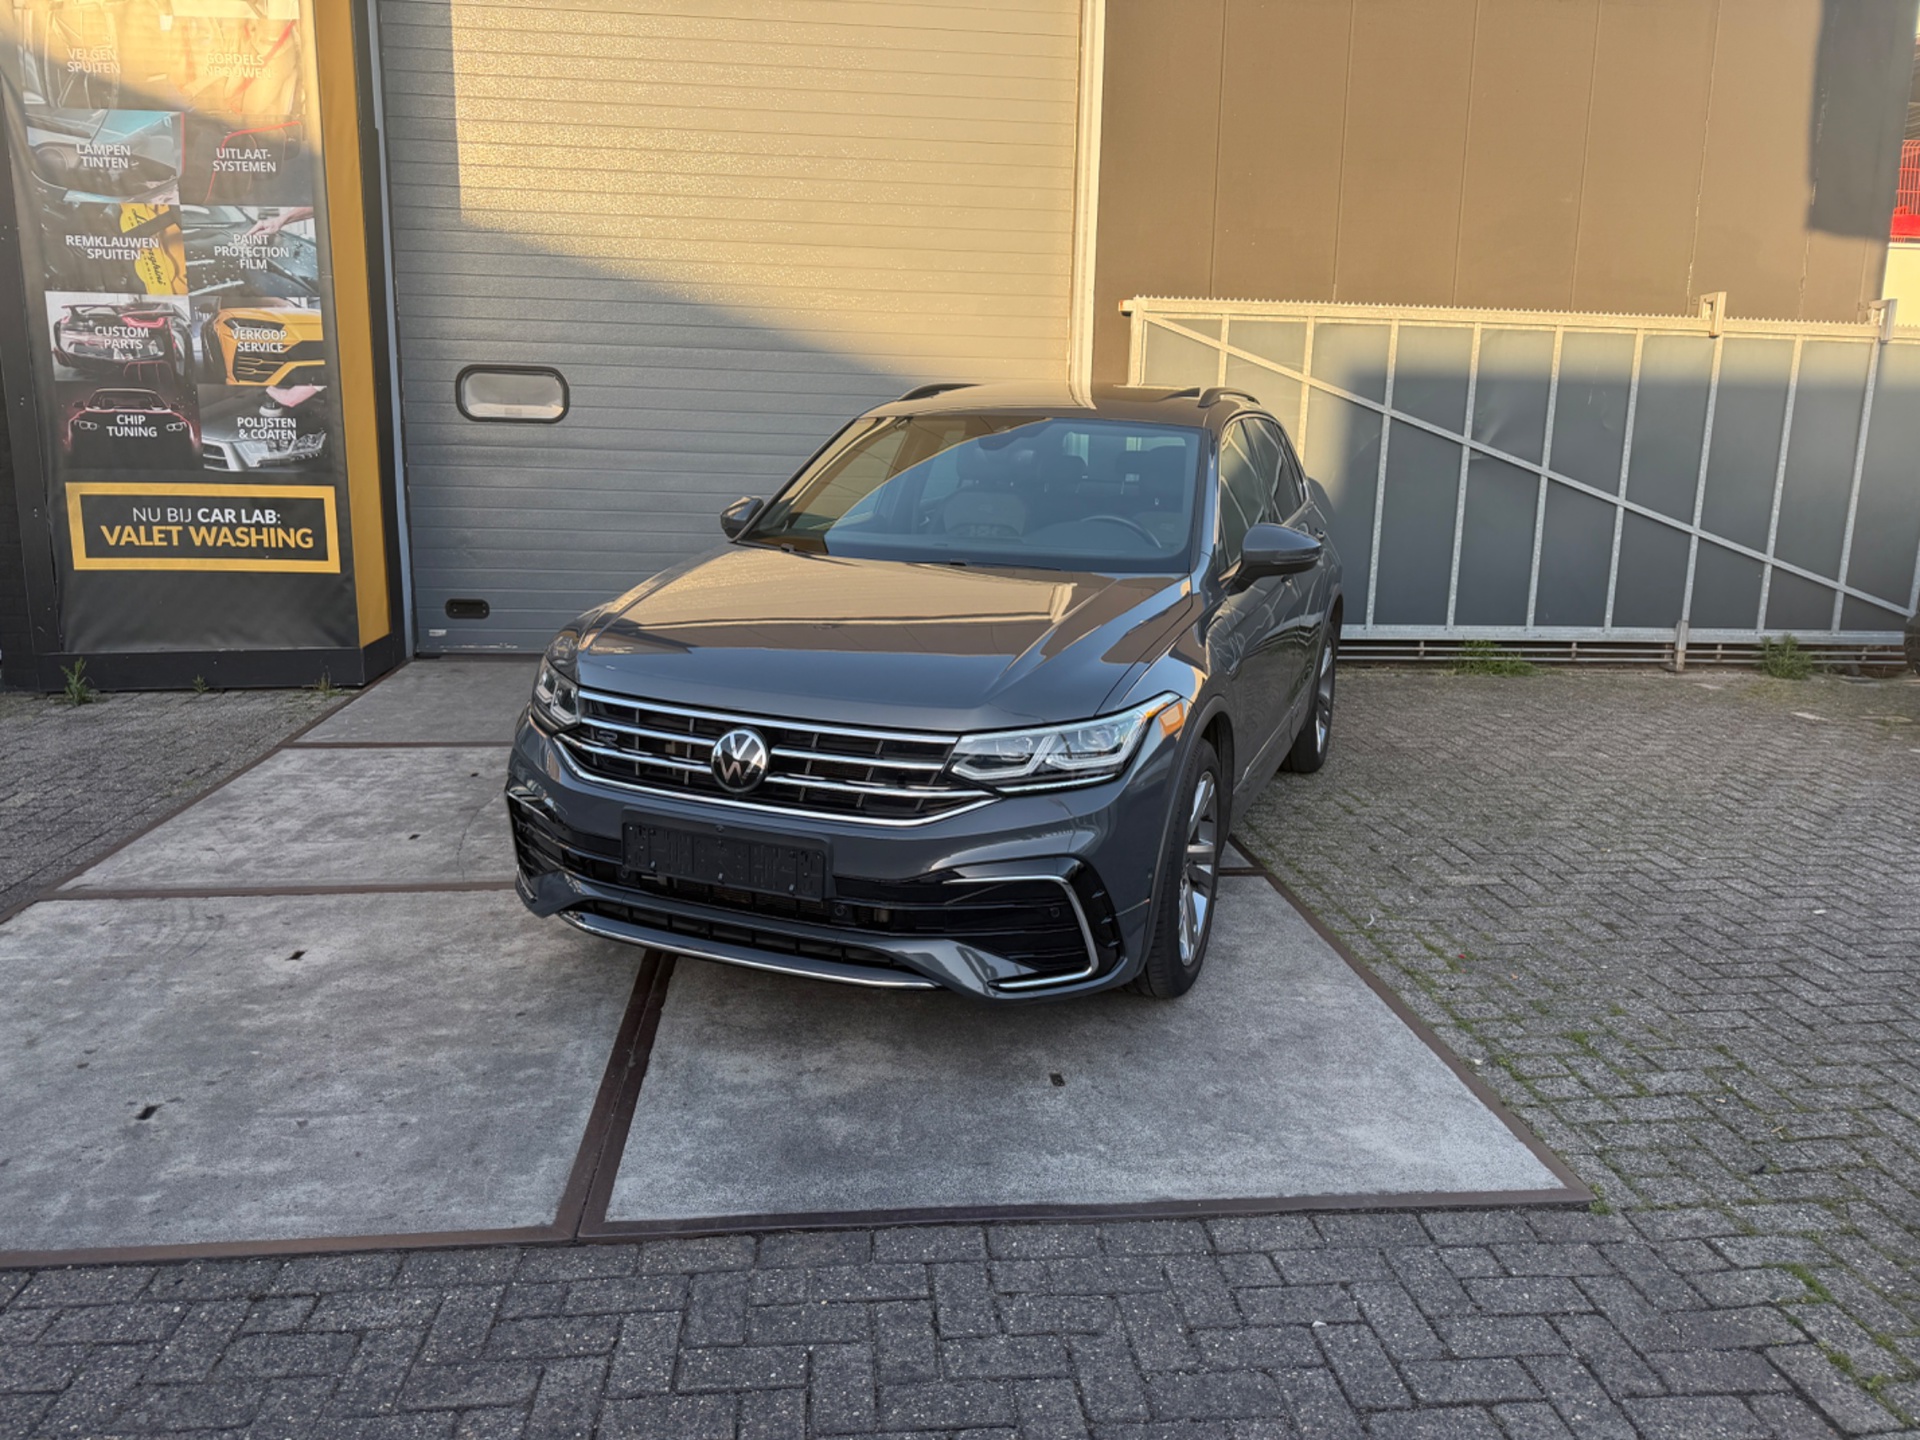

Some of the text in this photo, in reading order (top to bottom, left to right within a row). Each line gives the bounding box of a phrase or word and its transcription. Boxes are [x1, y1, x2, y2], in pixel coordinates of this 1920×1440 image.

[66, 48, 117, 60] VELGEN
[206, 53, 265, 65] GORDELS
[66, 61, 121, 74] SPUITEN
[76, 143, 131, 157] LAMPEN
[216, 148, 272, 161] UITLAAT-
[80, 156, 129, 169] TINTEN
[212, 160, 277, 173] SYSTEMEN
[65, 235, 159, 249] REMKLAUWEN
[233, 234, 269, 246] PAINT
[87, 247, 142, 261] SPUITEN
[214, 246, 290, 258] PROTECTION
[239, 258, 268, 270] FILM
[94, 326, 149, 338] CUSTOM
[231, 328, 287, 341] VERKOOP
[103, 338, 144, 350] PARTS
[237, 341, 284, 353] SERVICE
[116, 414, 147, 426] CHIP
[237, 417, 297, 430] POLIJSTEN
[106, 425, 158, 438] TUNING
[238, 428, 297, 440] & COATEN
[132, 507, 282, 525] NU BIJ CAR LAB:
[100, 525, 314, 549] VALET WASHING
[711, 728, 769, 793] VW
